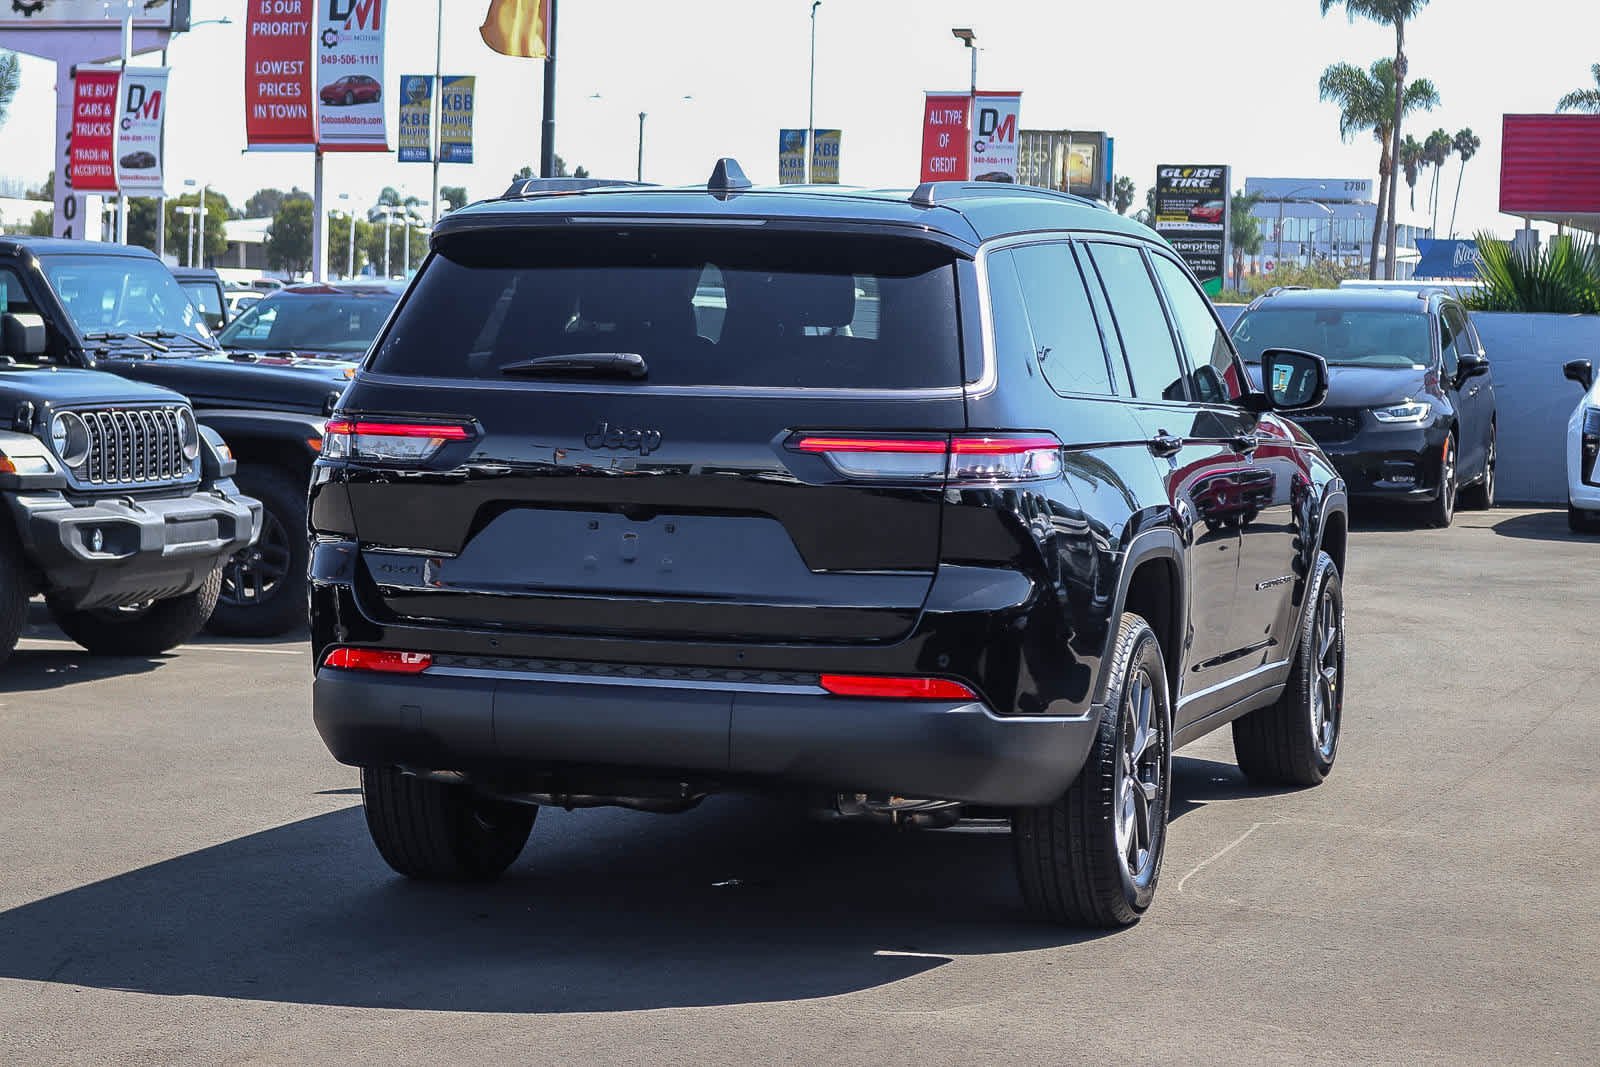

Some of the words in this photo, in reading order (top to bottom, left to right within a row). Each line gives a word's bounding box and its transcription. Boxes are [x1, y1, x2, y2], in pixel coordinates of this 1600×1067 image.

[261, 1, 272, 14] IS
[274, 1, 302, 14] OUR
[253, 22, 309, 36] PRIORITY
[255, 60, 305, 75] LOWEST
[80, 84, 94, 97] WE
[96, 84, 114, 97] BUY
[259, 82, 302, 97] PRICES
[79, 103, 103, 117] CARS
[105, 103, 112, 117] &
[442, 93, 473, 112] KBB
[254, 104, 267, 119] IN
[269, 104, 307, 119] TOWN
[401, 111, 431, 126] KBB
[930, 111, 944, 125] ALL
[945, 110, 963, 125] TYPE
[76, 123, 112, 137] TRUCKS
[979, 108, 1017, 144] DM
[940, 133, 951, 149] OF
[75, 165, 112, 177] ACCEPTED
[930, 157, 958, 174] CREDIT
[1160, 167, 1222, 179] GLOBE
[1170, 178, 1213, 188] TIRE
[1171, 241, 1220, 252] nterprise
[584, 421, 663, 457] Jeep
